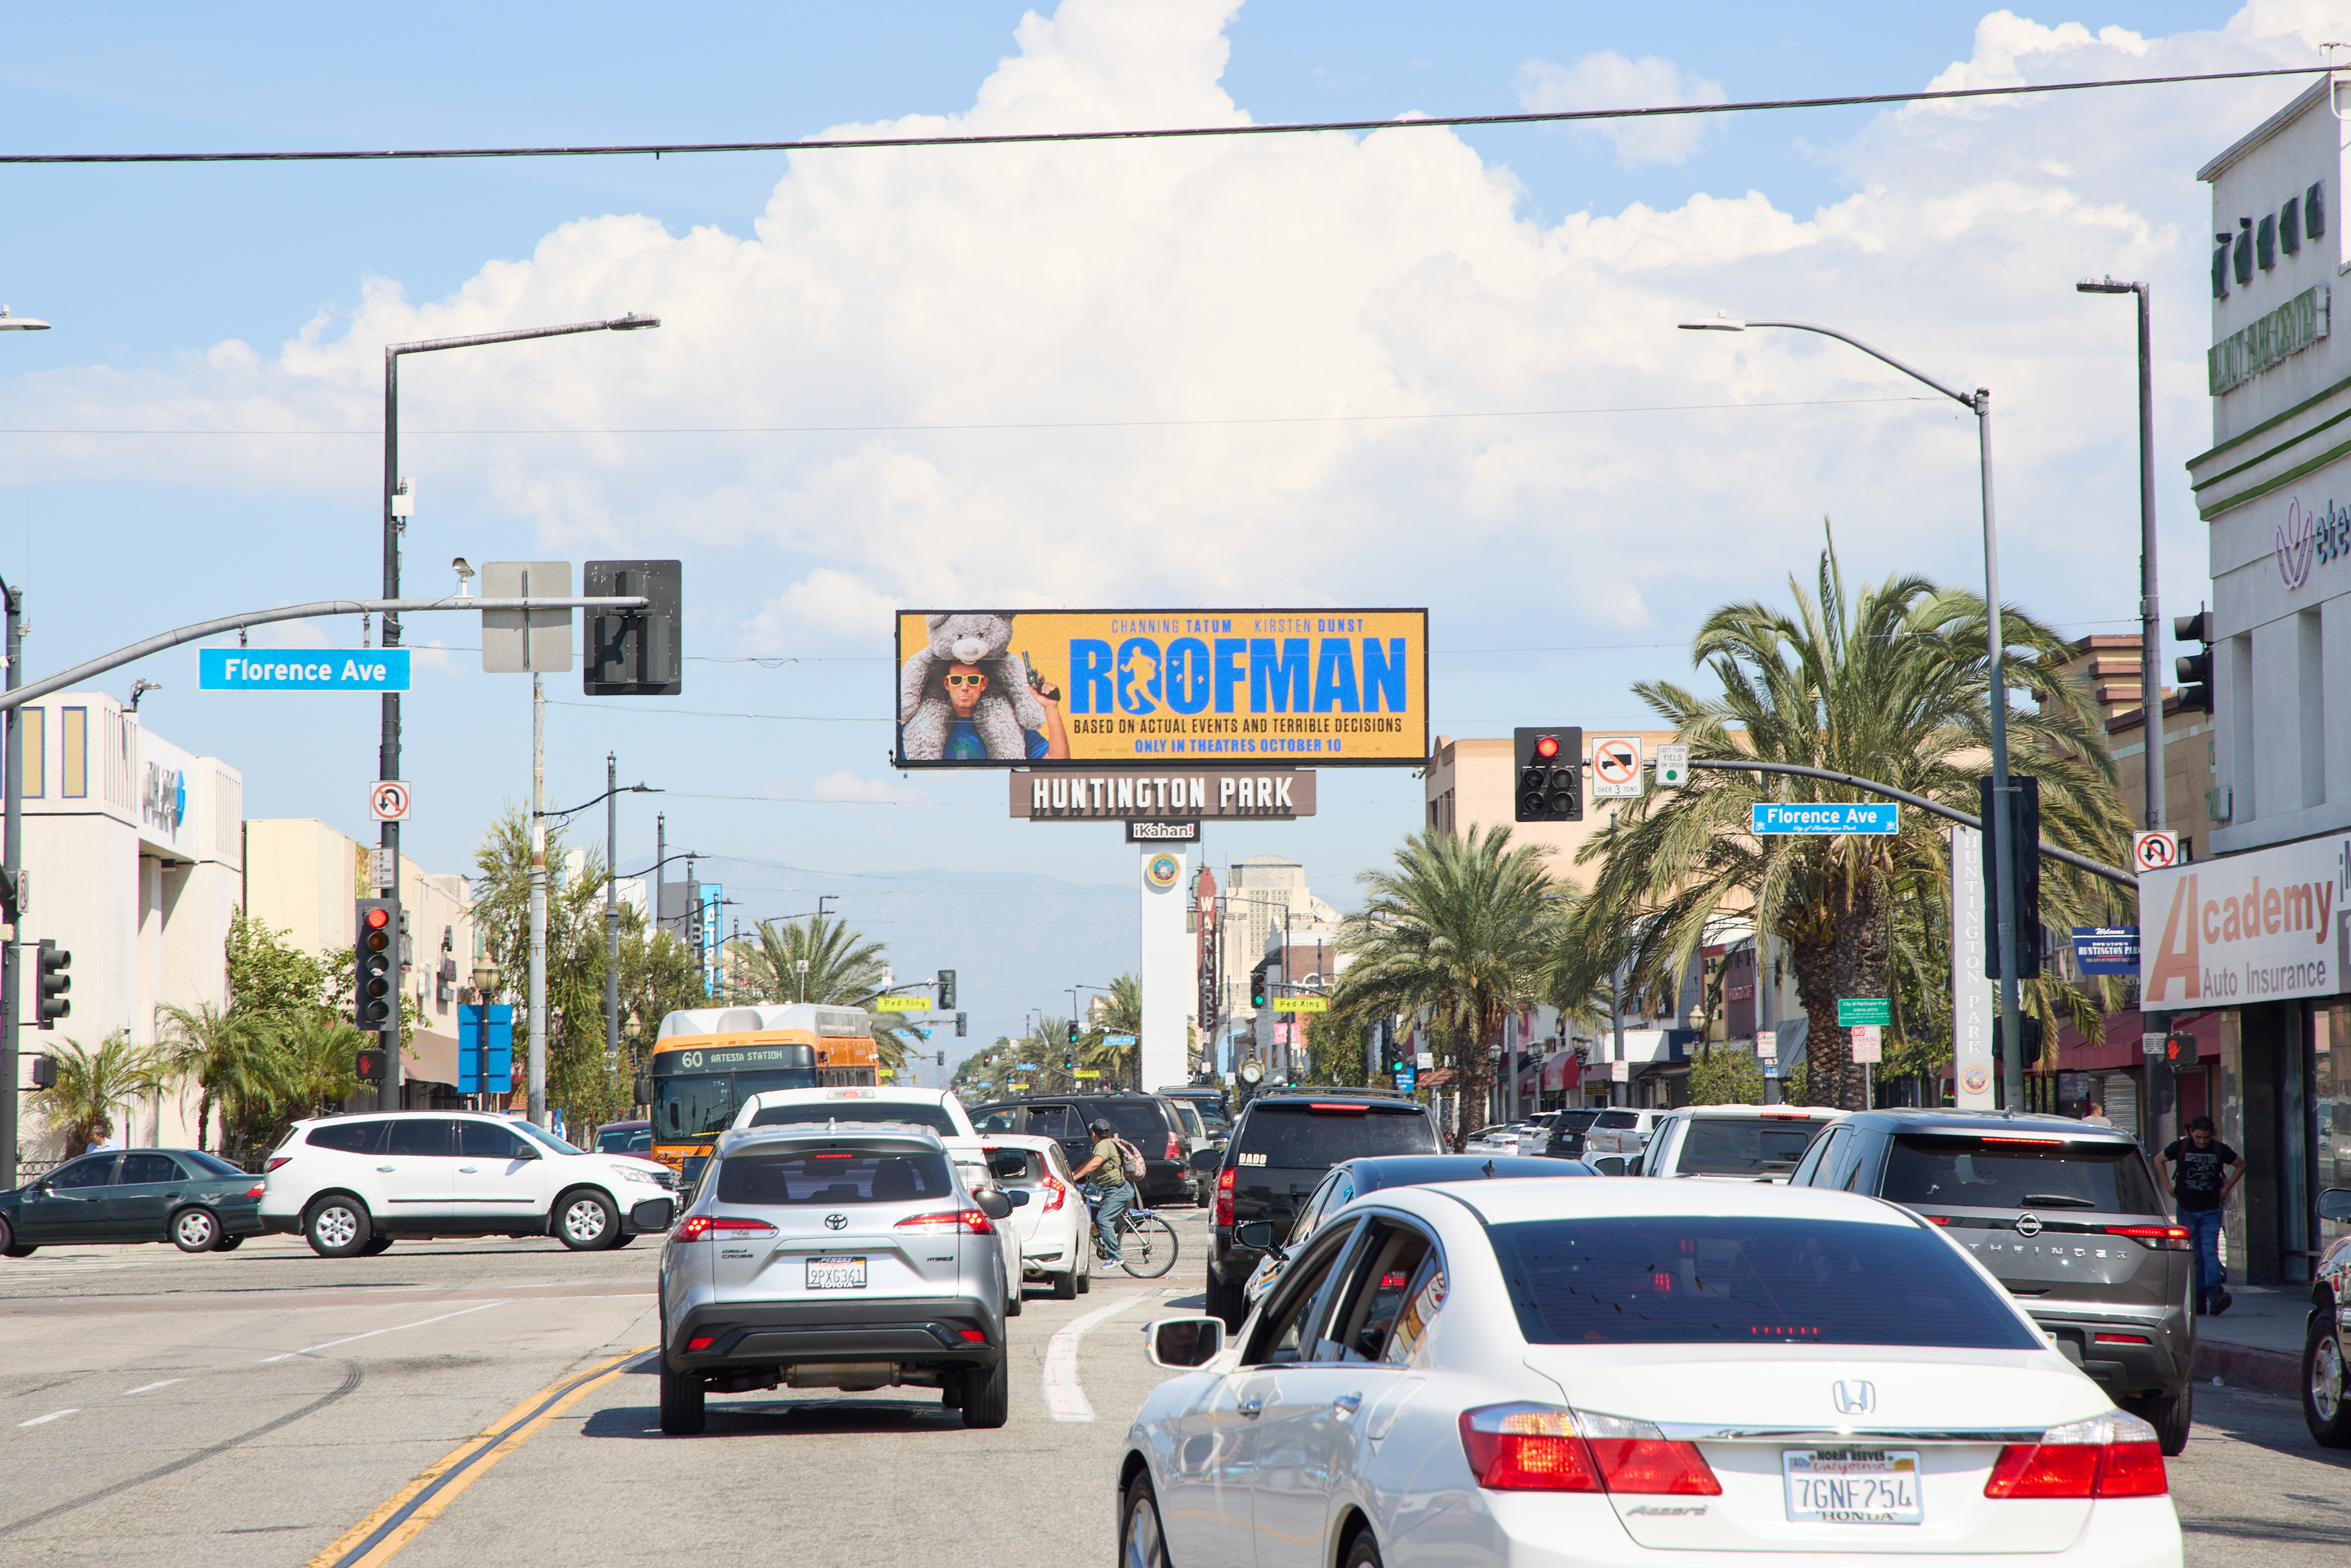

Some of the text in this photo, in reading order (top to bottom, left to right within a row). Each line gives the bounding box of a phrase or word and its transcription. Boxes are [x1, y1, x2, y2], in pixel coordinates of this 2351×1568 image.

[2315, 499, 2351, 564] ete
[1111, 619, 1232, 633] CHANNING TATUM
[1255, 618, 1364, 633] KIRSTEN DUNST
[225, 658, 387, 681] Florence Ave
[1070, 637, 1406, 715] ROOFMAN
[1074, 718, 1402, 733] BASED ON ACTUAL EVENTS AND TERRIBLE DECISIONS
[1135, 738, 1342, 753] ONLY IN THEATRES OCTOBER 10
[1034, 777, 1294, 809] HUNTINGTON PARK
[1614, 784, 1621, 794] 3
[1767, 808, 1878, 824] Florence Ave
[1133, 823, 1195, 838] iKahan!
[1965, 834, 1980, 983] HUNTINGTON
[2145, 873, 2334, 1002] Academy
[704, 907, 716, 986] AT&T
[2078, 947, 2124, 955] HUNTINGTON
[1201, 896, 1215, 1027] WARNERS
[2203, 959, 2327, 999] Auto Insurance
[1300, 1000, 1320, 1009] Xing
[1854, 1027, 1864, 1036] NO
[1968, 994, 1982, 1053] PARK
[682, 1050, 783, 1068] 60 ARTESIA STATION
[1969, 1243, 2128, 1259] THFINDER
[811, 1269, 862, 1284] 9PXG361
[1817, 1450, 1886, 1461] NORM REEVES
[1813, 1462, 1890, 1476] California
[1795, 1476, 1912, 1509] 7GNF254
[1821, 1512, 1895, 1521] HONDA
